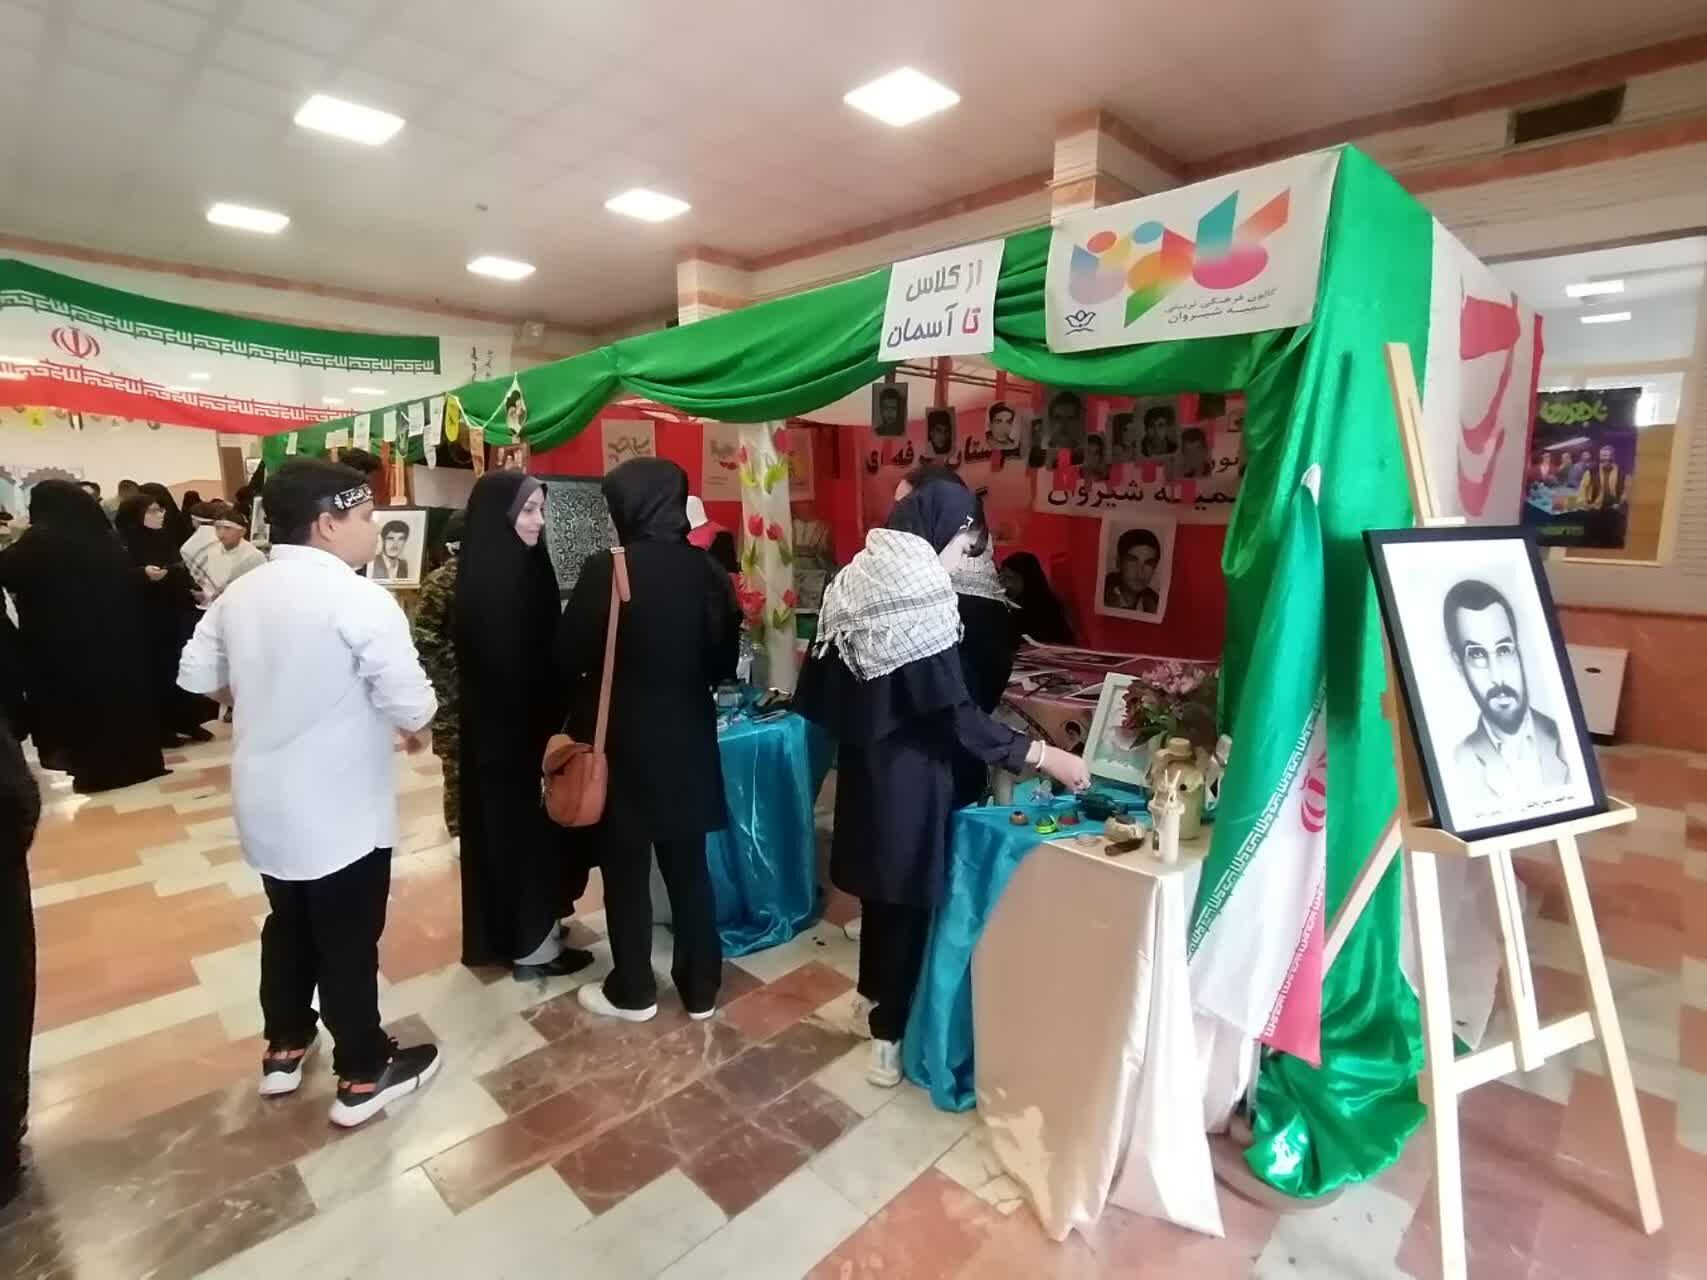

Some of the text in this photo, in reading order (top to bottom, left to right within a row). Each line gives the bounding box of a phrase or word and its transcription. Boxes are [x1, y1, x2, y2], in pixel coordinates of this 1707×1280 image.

[905, 259, 983, 302] از کلاس
[887, 303, 981, 348] تا آسمان
[1168, 307, 1222, 324] شیروان
